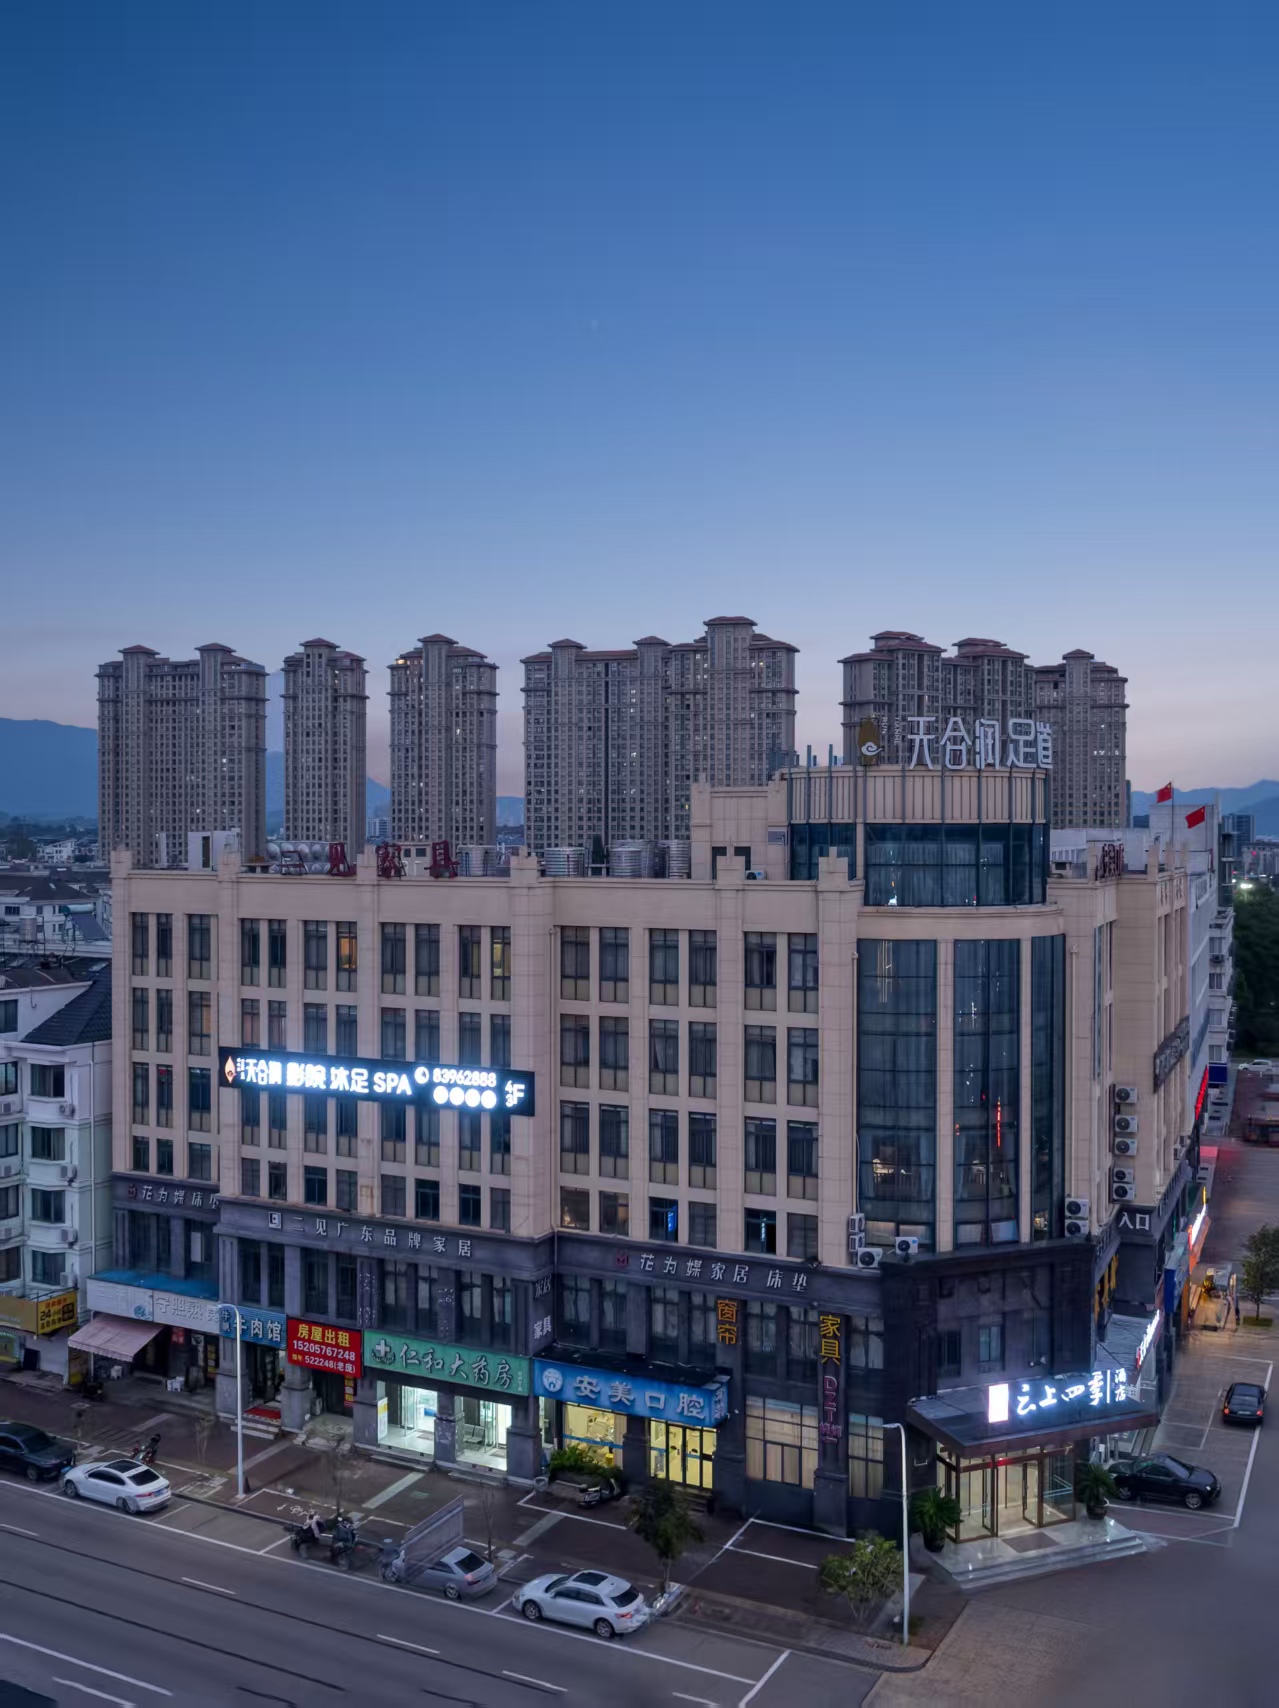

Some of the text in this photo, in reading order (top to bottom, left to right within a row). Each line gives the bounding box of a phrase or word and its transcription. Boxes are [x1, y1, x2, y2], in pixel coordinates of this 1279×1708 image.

[907, 716, 1053, 770] 天合润足道
[373, 1071, 413, 1096] SPA
[432, 1067, 497, 1088] 83962888
[292, 1216, 472, 1257] 二见广东品牌家居
[1118, 1211, 1150, 1231] 入口
[639, 1252, 808, 1293] 花为媒家居 床垫
[234, 1314, 281, 1343] 牛肉馆
[297, 1323, 350, 1347] 房屋出租
[819, 1314, 841, 1365] 家具
[292, 1339, 356, 1361] 15205767248
[399, 1344, 513, 1389] 仁和大药房
[573, 1375, 705, 1420] 安美口腔
[1016, 1371, 1104, 1416] 云上四季
